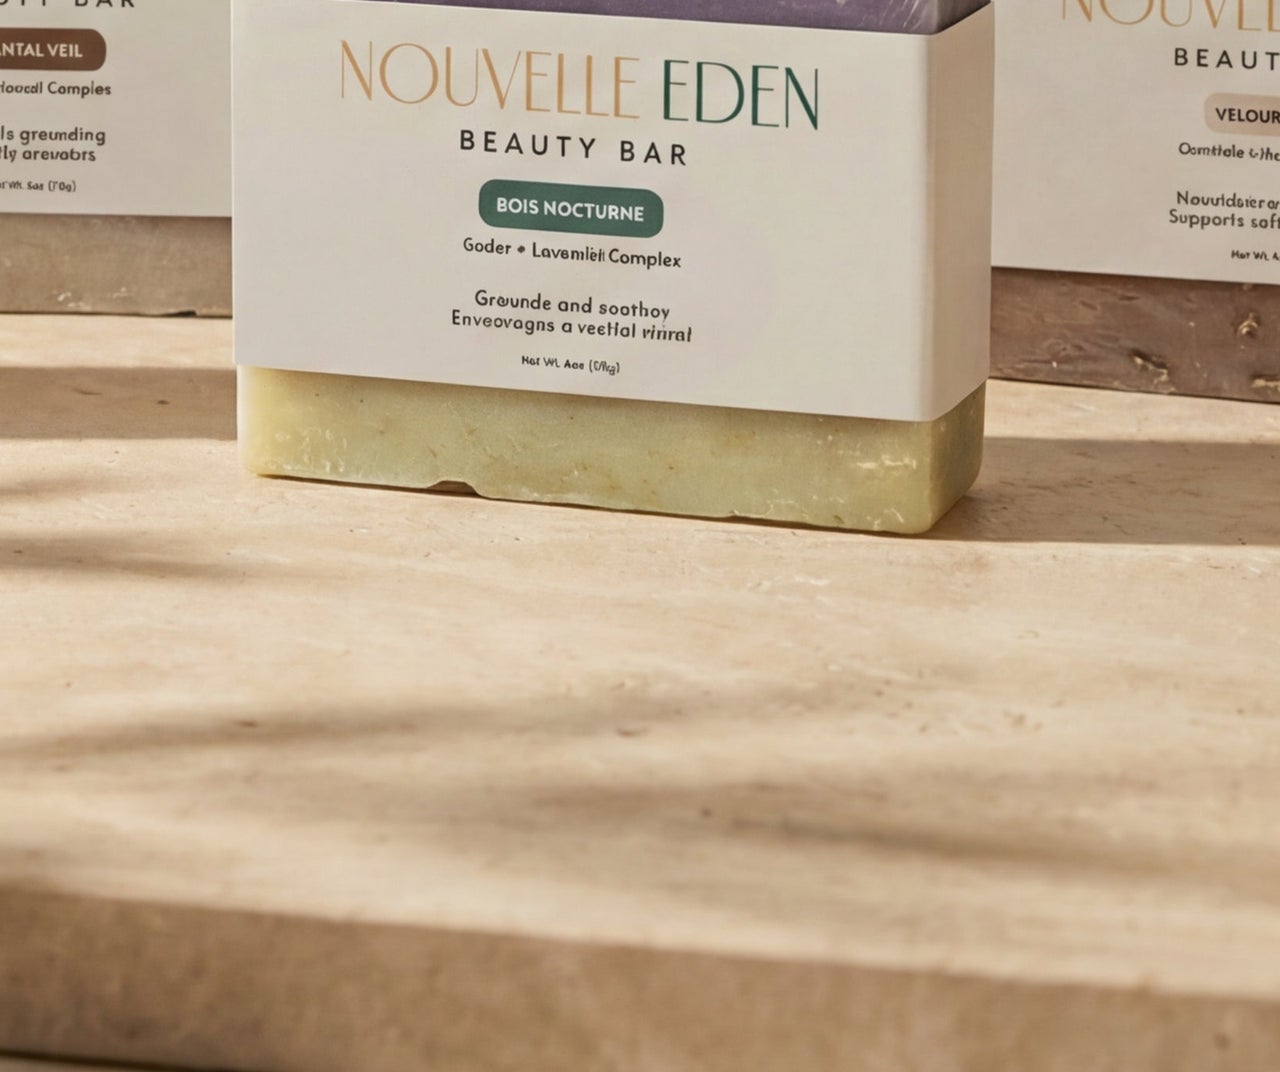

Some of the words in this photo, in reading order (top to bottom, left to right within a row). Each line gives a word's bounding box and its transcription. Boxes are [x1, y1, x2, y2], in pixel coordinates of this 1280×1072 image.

[47, 43, 83, 57] VEIL
[340, 40, 640, 120] NOUVELLE
[662, 58, 820, 130] EDEN
[460, 129, 597, 159] BEAUTY
[620, 139, 688, 166] BAR
[496, 197, 539, 215] BOIS
[544, 200, 645, 222] NOCTURNE
[1169, 209, 1244, 230] Supports
[609, 248, 681, 269] Complex
[558, 297, 592, 313] and
